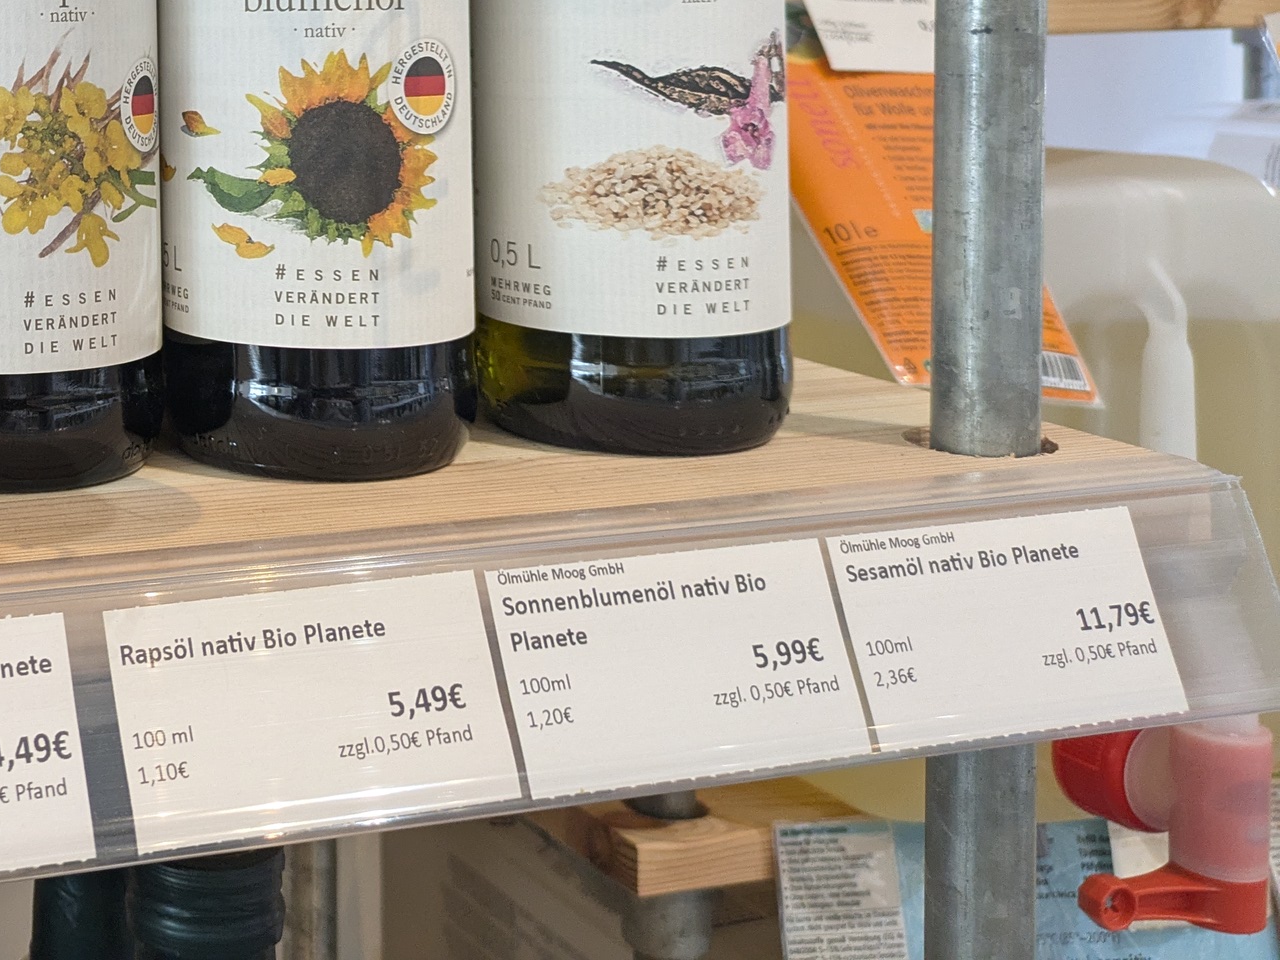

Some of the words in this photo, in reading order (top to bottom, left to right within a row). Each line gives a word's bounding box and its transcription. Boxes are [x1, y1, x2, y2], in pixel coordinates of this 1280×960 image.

[50, 8, 87, 23] nativ
[392, 42, 448, 84] HERGESTELLT
[445, 65, 452, 78] IN
[394, 93, 452, 128] DEUTSCHLAND
[490, 238, 518, 268] 0,5
[528, 244, 541, 270] L
[491, 276, 551, 296] MEHRWEG
[491, 290, 501, 303] 50
[502, 294, 520, 305] CENT
[522, 298, 552, 310] PFAND
[23, 312, 117, 331] VERÄNDERT
[25, 341, 58, 354] DIE
[72, 334, 117, 351] WELT
[840, 538, 886, 554] Ölmühle
[889, 535, 921, 550] Moog
[922, 531, 955, 546] GmbH
[497, 570, 548, 586] Ölmühle
[552, 566, 586, 582] Moog
[588, 563, 625, 578] GmbH
[846, 557, 924, 583] Sesamöl
[929, 552, 973, 575] nativ
[978, 549, 1008, 569] Bio
[1011, 542, 1079, 565] Planete
[502, 580, 676, 616] Sonnenblumenöl
[681, 576, 730, 599] nativ
[735, 573, 766, 593] Bio
[1076, 601, 1155, 634] 11,79€
[120, 637, 194, 668] Rapsöl
[201, 632, 256, 657] nativ
[262, 628, 297, 650] Bio
[304, 619, 386, 645] Planete
[510, 629, 588, 653] Planete
[866, 637, 913, 657] 100ml
[751, 638, 824, 672] 5,99€
[1042, 649, 1072, 669] zzgl.
[1075, 643, 1116, 665] 0,50€
[1117, 639, 1157, 658] Pfand
[519, 674, 571, 696] 100ml
[873, 668, 918, 689] 2,36€
[388, 684, 467, 721] 5,49€
[713, 687, 747, 709] zzgl.
[750, 681, 794, 704] 0,50€
[797, 675, 840, 696] Pfand
[526, 707, 574, 731] 1,20€
[132, 730, 166, 750] 100
[172, 725, 194, 743] ml
[425, 724, 474, 747] Pfand
[137, 761, 190, 787] 1,10€
[15, 778, 68, 802] Pfand
